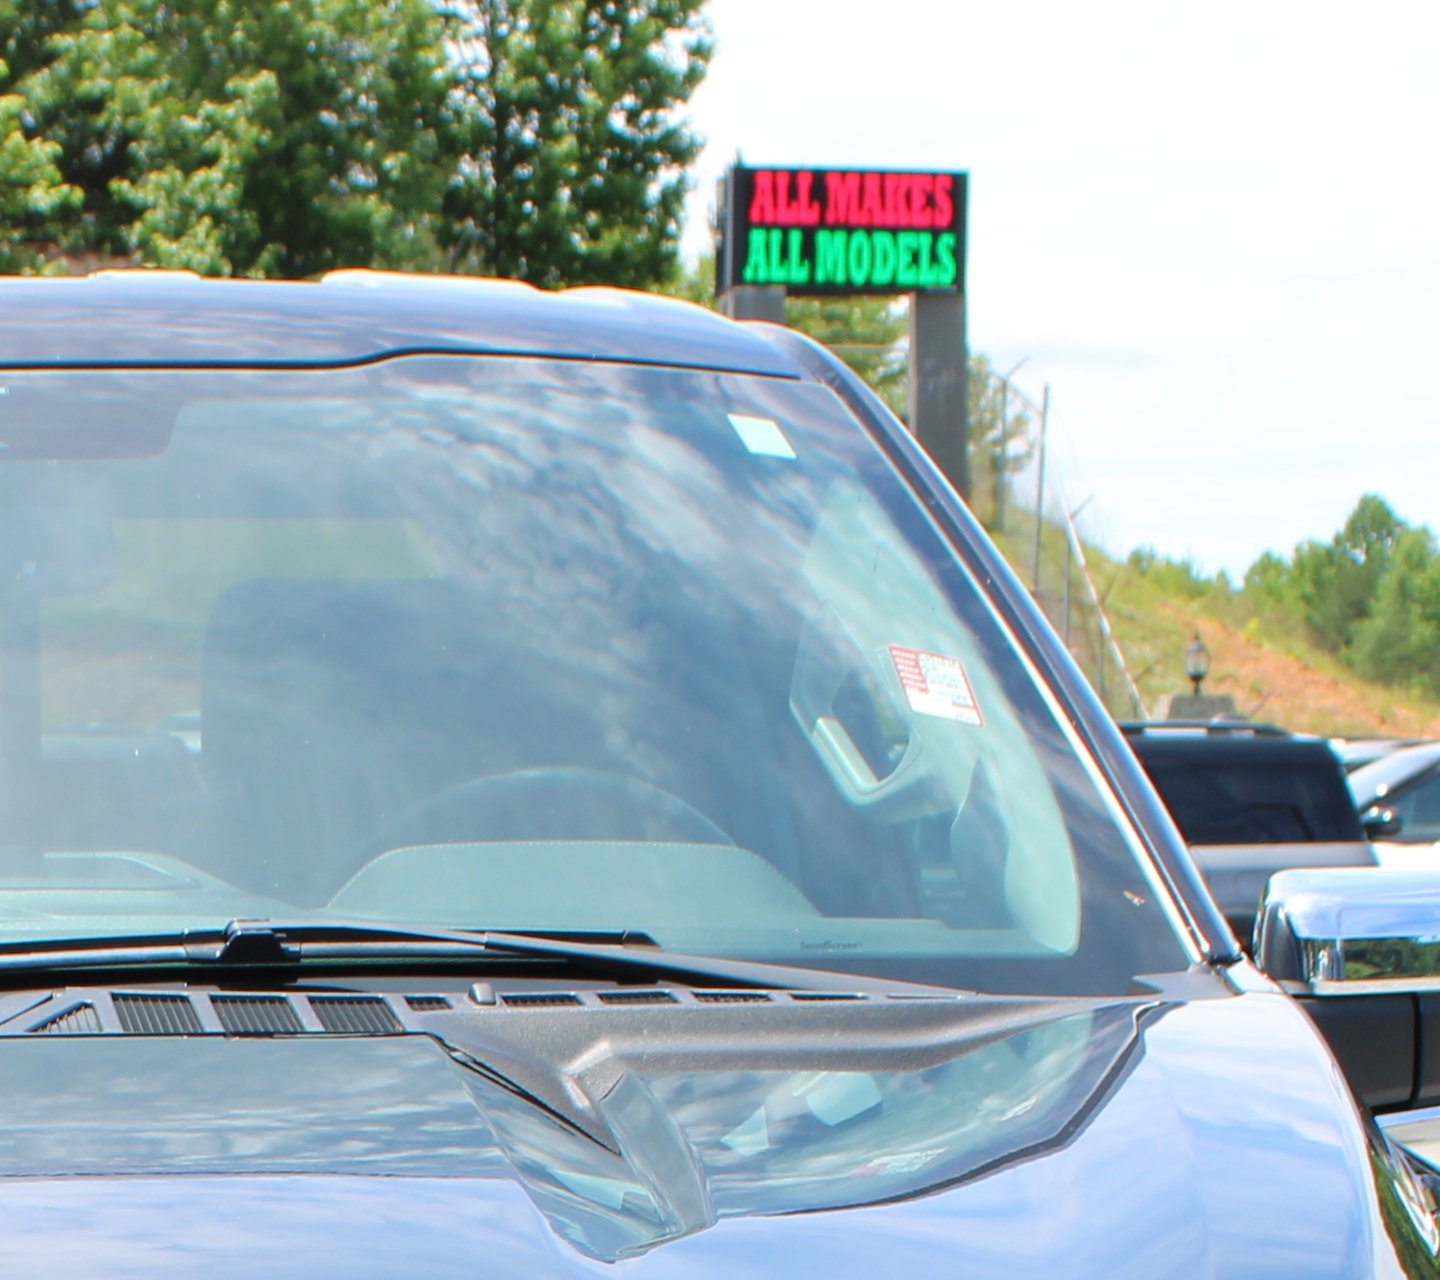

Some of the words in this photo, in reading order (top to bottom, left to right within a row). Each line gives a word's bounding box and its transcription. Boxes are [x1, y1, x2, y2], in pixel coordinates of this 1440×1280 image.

[749, 169, 820, 226] ALL
[825, 171, 954, 228] MAKES
[743, 227, 810, 284] ALL
[814, 229, 958, 286] MODELS
